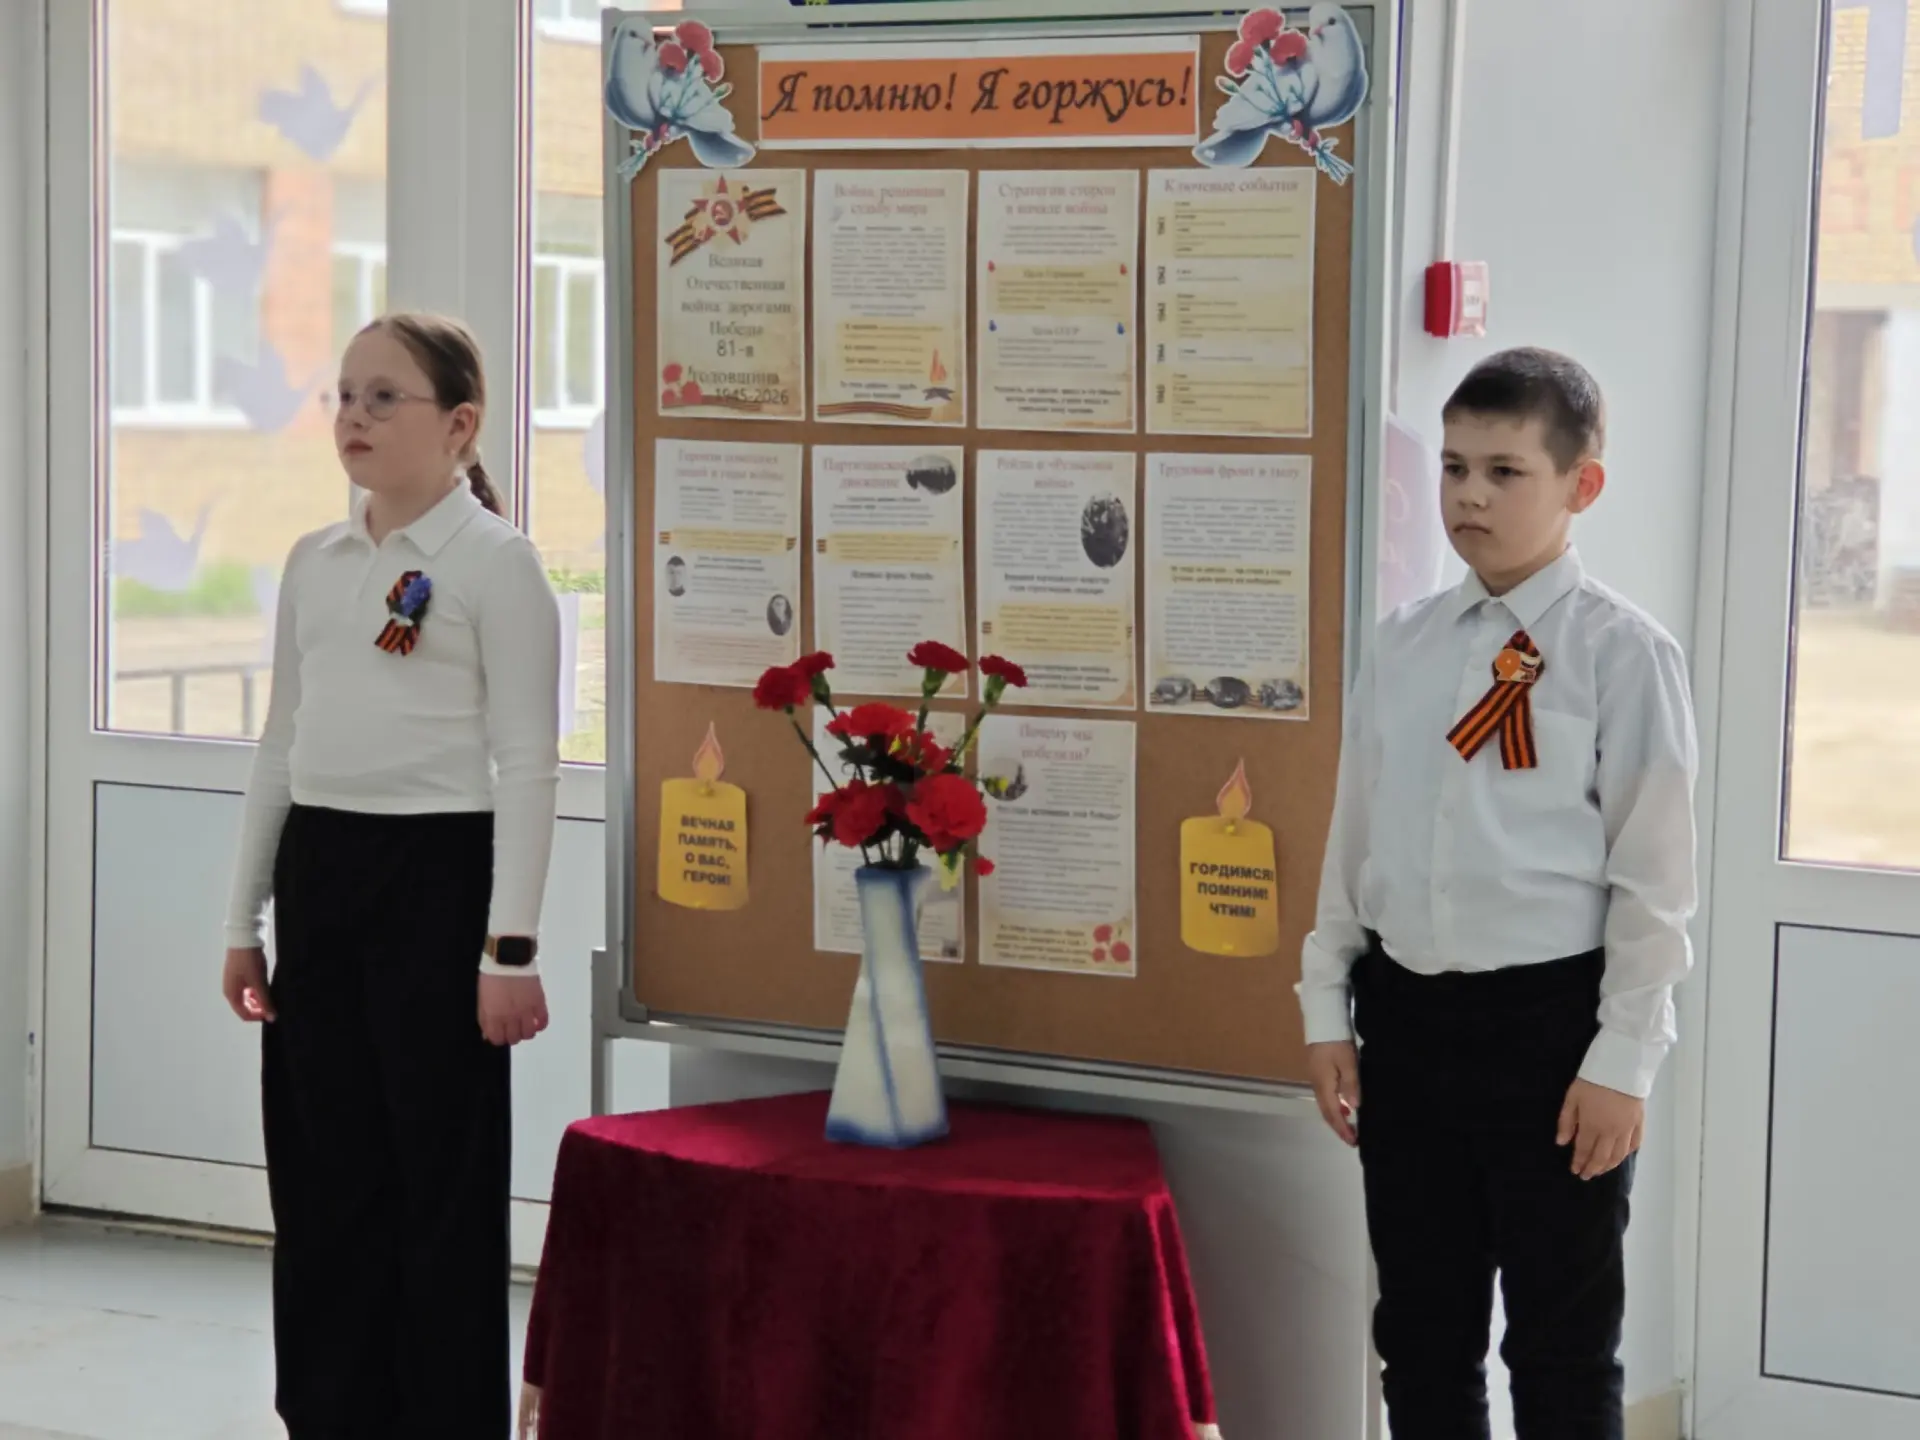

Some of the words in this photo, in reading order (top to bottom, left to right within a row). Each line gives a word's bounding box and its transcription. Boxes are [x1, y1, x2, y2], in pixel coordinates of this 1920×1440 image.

[761, 72, 807, 119] Я
[812, 73, 955, 112] помню!
[972, 68, 1008, 114] Я
[1014, 66, 1190, 122] горжусь!
[1165, 179, 1235, 193] Ключевые
[1239, 176, 1300, 191] события
[709, 254, 763, 267] Великая
[687, 276, 785, 290] Отечественная
[716, 387, 789, 405] 1945-2026
[681, 814, 735, 832] ВЕЧНАЯ
[685, 852, 695, 863] О
[1190, 862, 1274, 881] ГОРДИМСЯ!
[1198, 882, 1268, 900] ПОМНИМ!
[1209, 902, 1256, 918] ЧТИМ!
